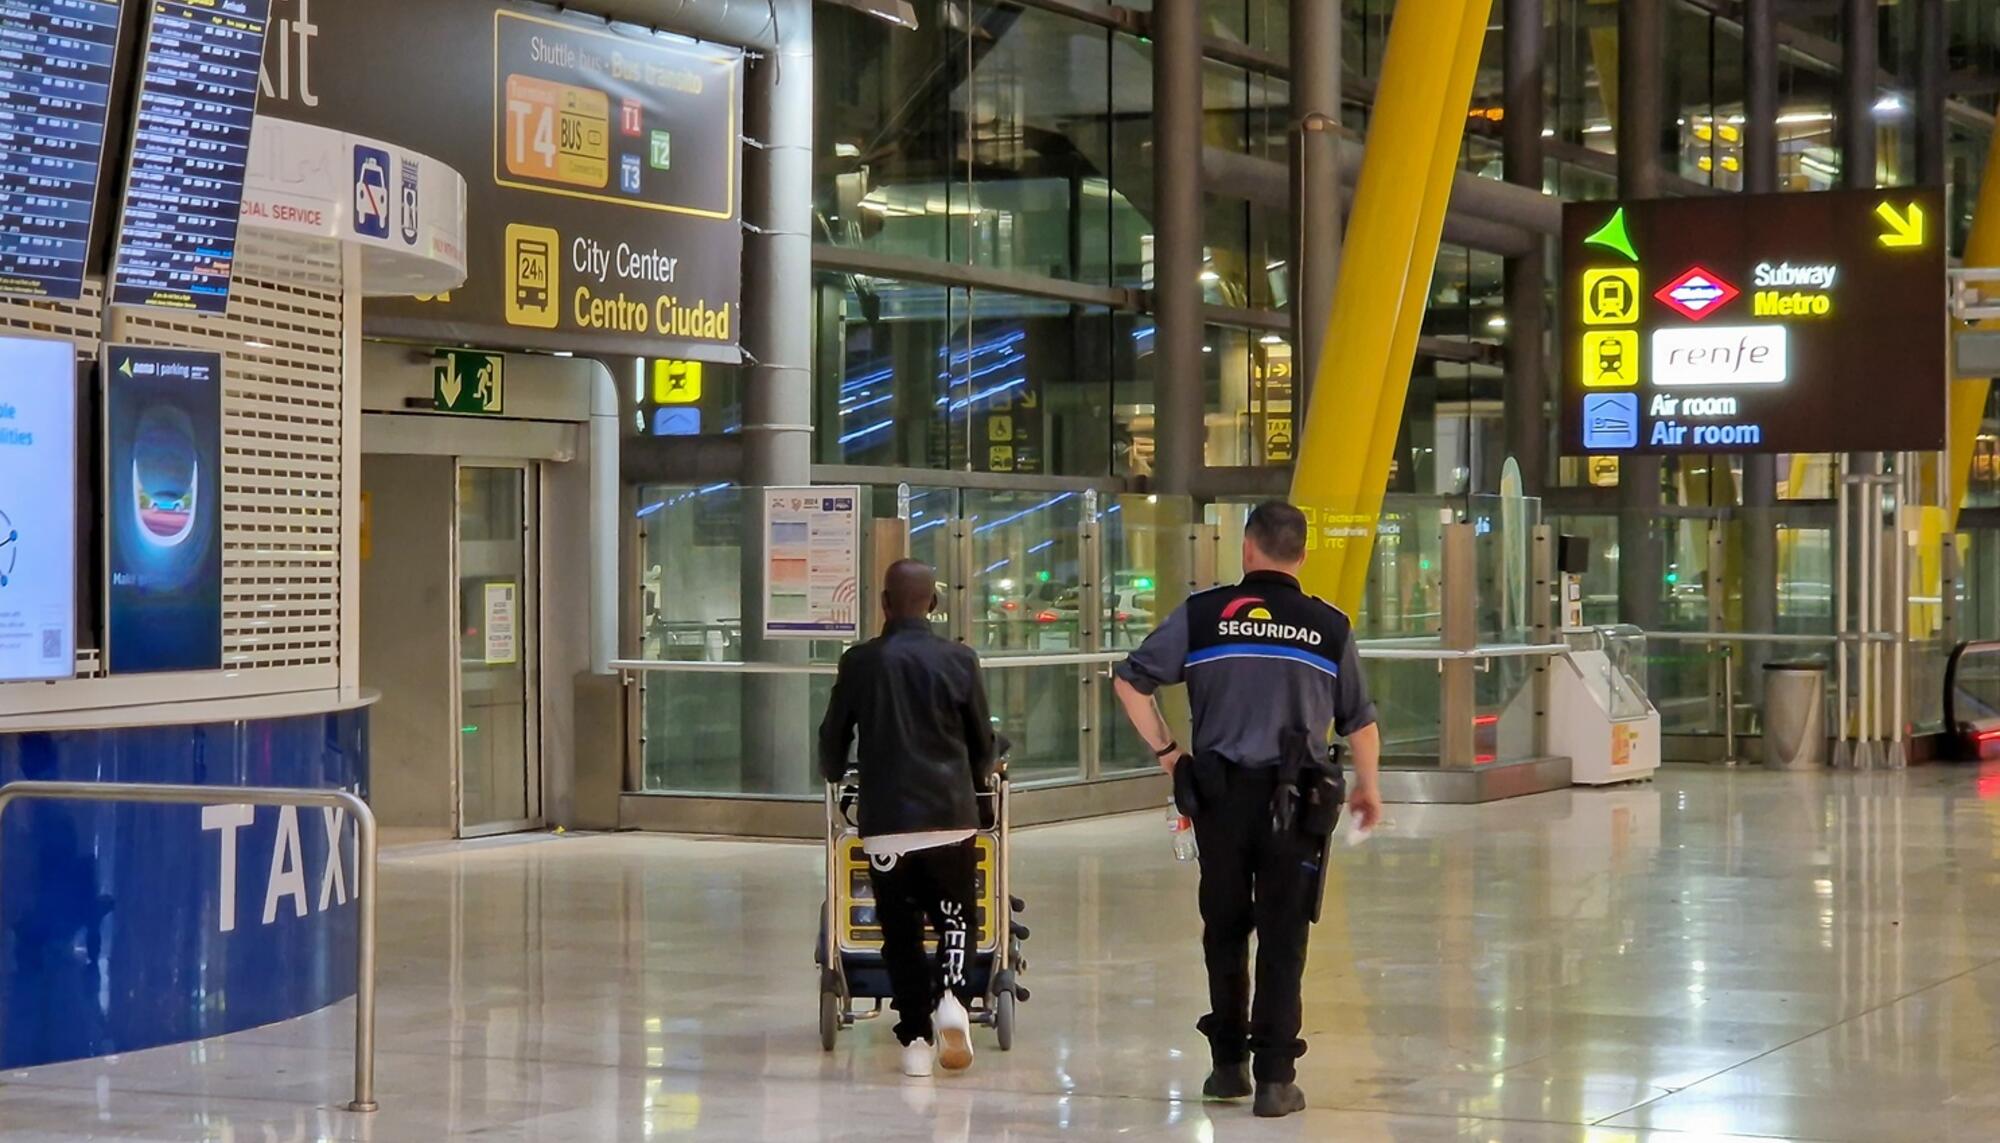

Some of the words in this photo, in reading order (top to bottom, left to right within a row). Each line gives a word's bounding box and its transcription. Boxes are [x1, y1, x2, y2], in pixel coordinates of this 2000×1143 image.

[531, 36, 576, 69] Shuttle
[611, 51, 641, 81] Bus
[623, 106, 640, 131] T1
[508, 100, 556, 168] T4
[561, 118, 583, 150] BUS
[651, 140, 669, 165] T2
[622, 164, 640, 189] T3
[272, 204, 322, 225] SERVICE
[522, 257, 544, 281] 24h
[572, 236, 610, 282] City
[616, 242, 678, 283] Center
[1755, 262, 1837, 288] Subway
[574, 286, 648, 332] Centro
[656, 294, 729, 340] Ciudad
[1754, 290, 1830, 316] Metro
[1669, 335, 1769, 373] renfe
[160, 362, 189, 378] parking
[1651, 395, 1675, 416] Air
[1682, 396, 1736, 415] room
[1651, 422, 1687, 446] Air
[1694, 423, 1760, 444] room
[1218, 620, 1322, 646] SEGURIDAD
[201, 783, 359, 932] TAXI
